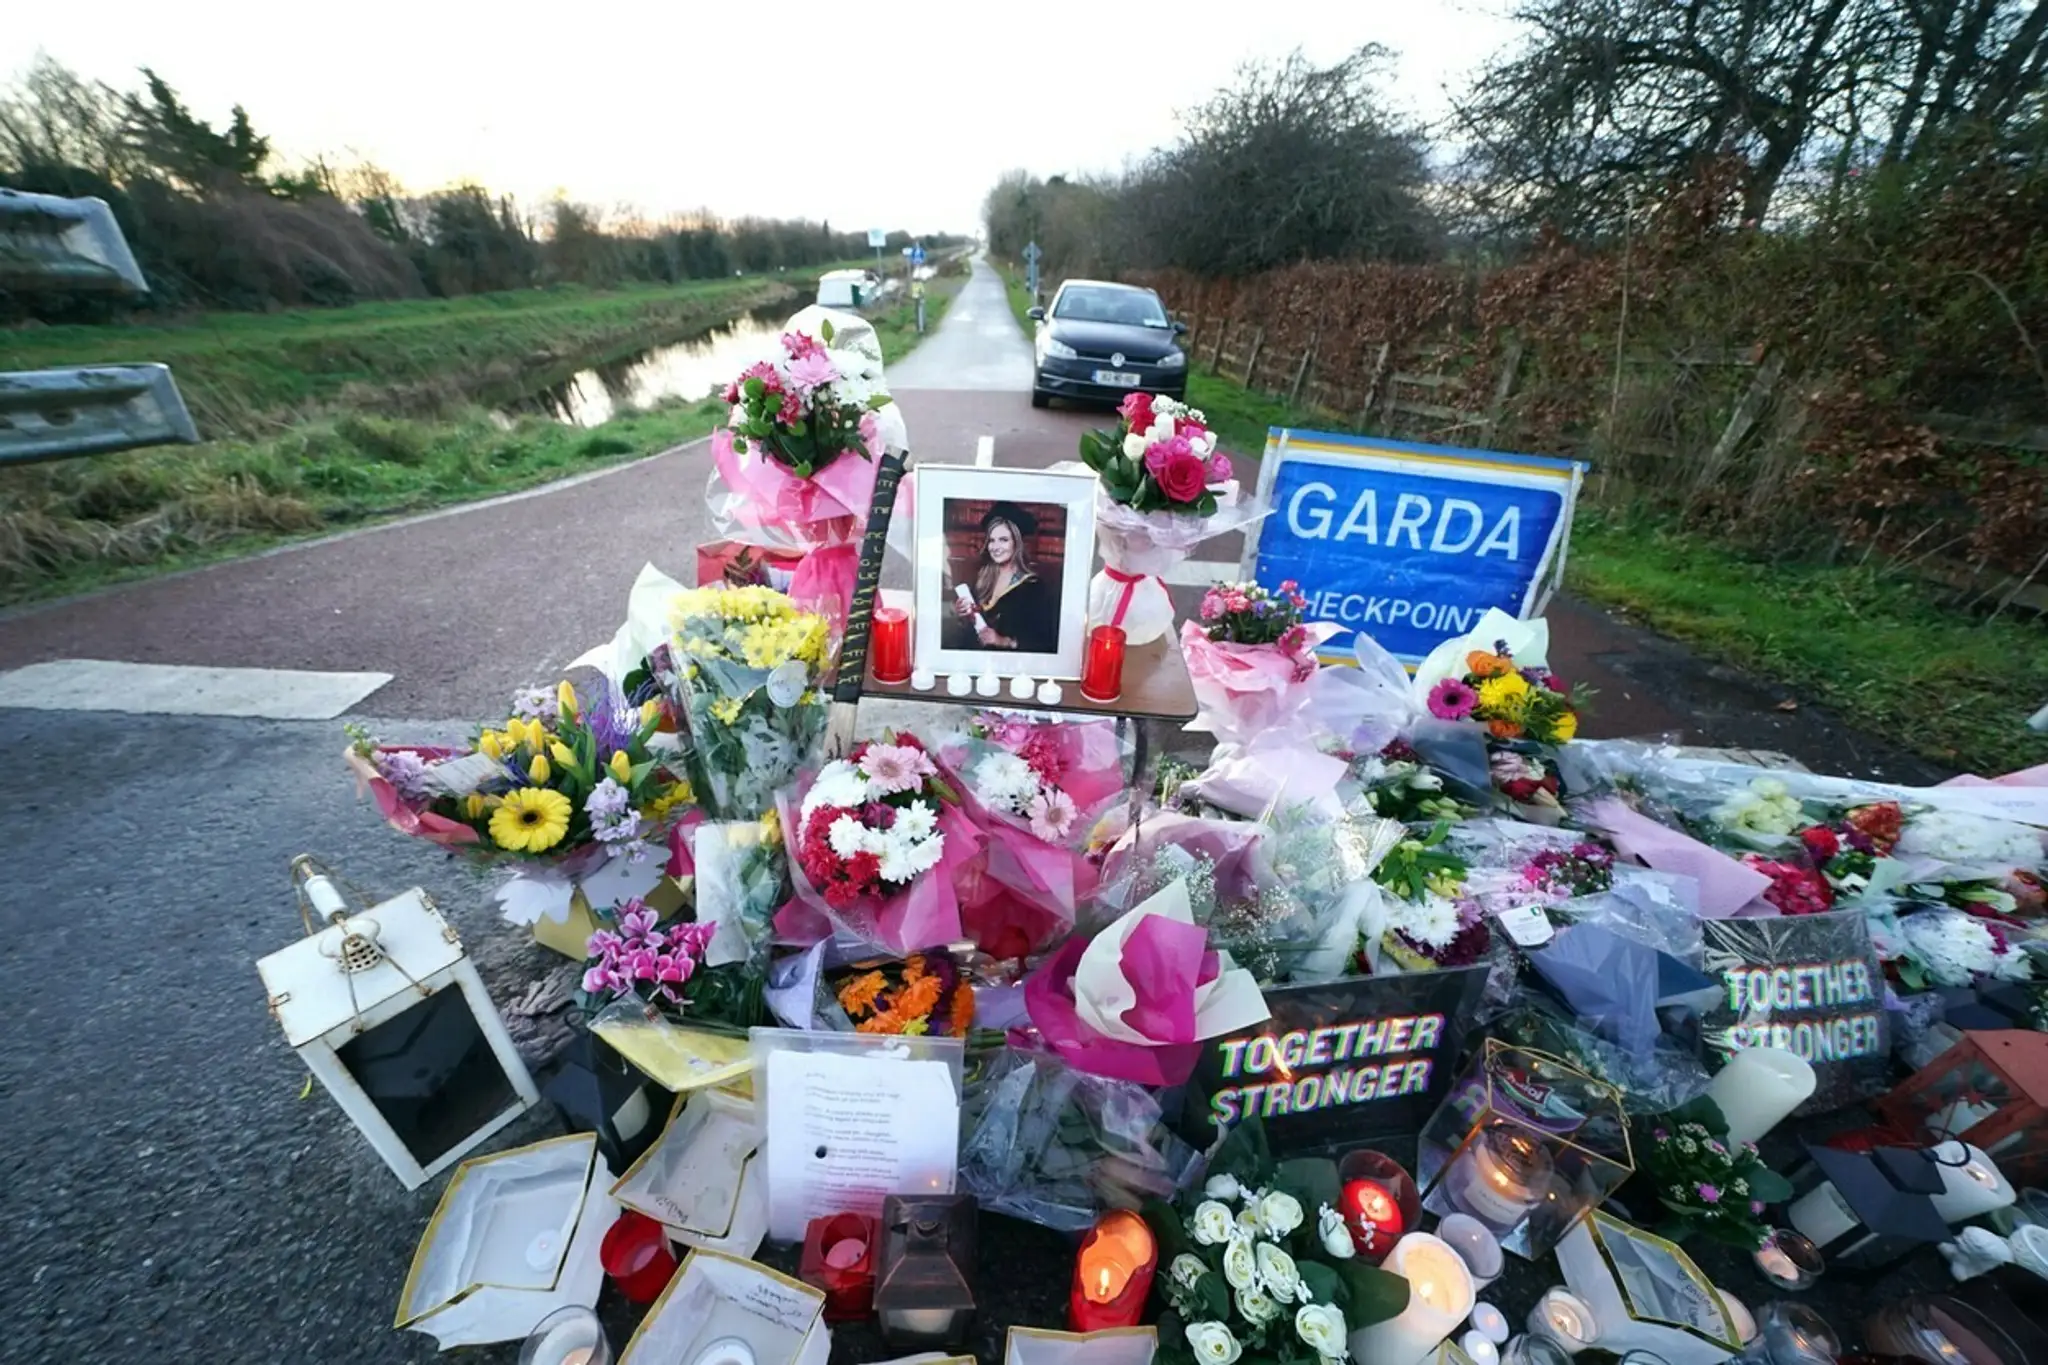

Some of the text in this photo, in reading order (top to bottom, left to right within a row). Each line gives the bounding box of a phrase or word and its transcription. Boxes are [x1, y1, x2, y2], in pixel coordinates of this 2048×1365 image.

[1287, 482, 1521, 561] GARDA
[1299, 588, 1489, 633] HECKPOINT
[1722, 961, 1875, 1012] TOGETHER
[1219, 1013, 1446, 1077] TOGETHER
[1208, 1058, 1433, 1126] STRONGER
